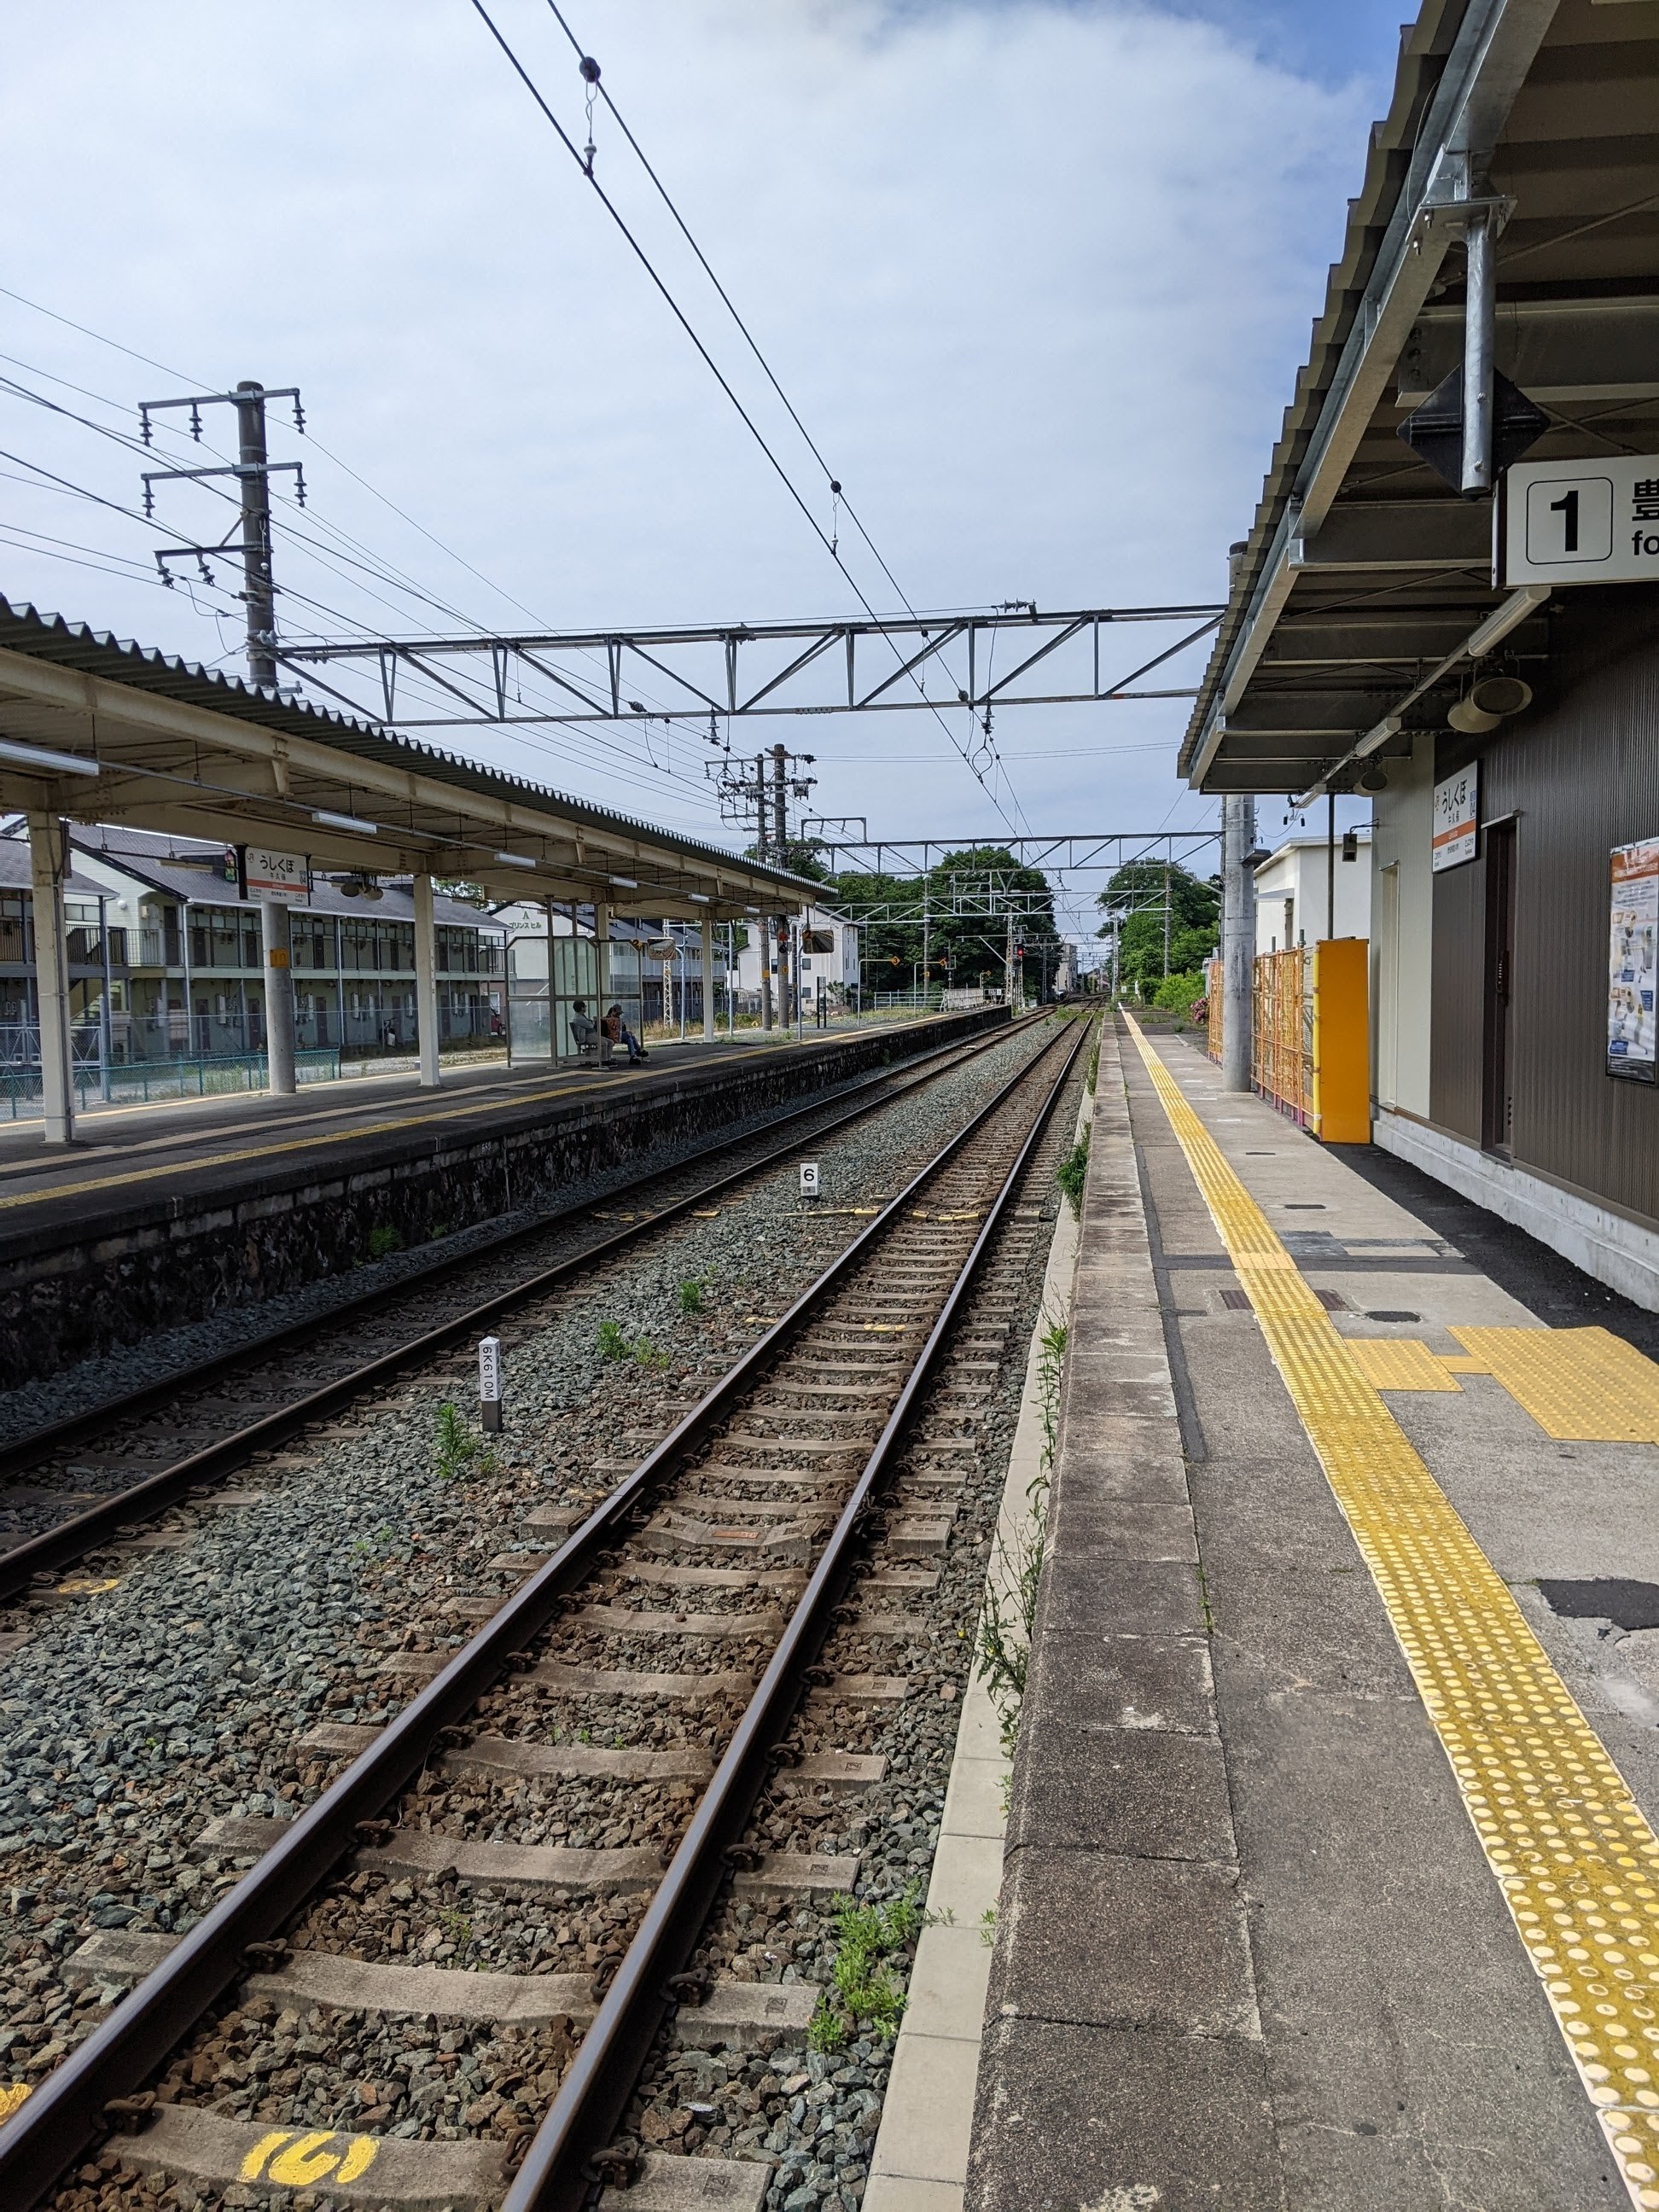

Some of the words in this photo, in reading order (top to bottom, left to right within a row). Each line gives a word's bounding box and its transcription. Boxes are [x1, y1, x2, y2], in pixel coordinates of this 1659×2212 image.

[1550, 490, 1579, 552] 1
[803, 1168, 815, 1181] 6
[482, 1346, 494, 1399] 6K610M
